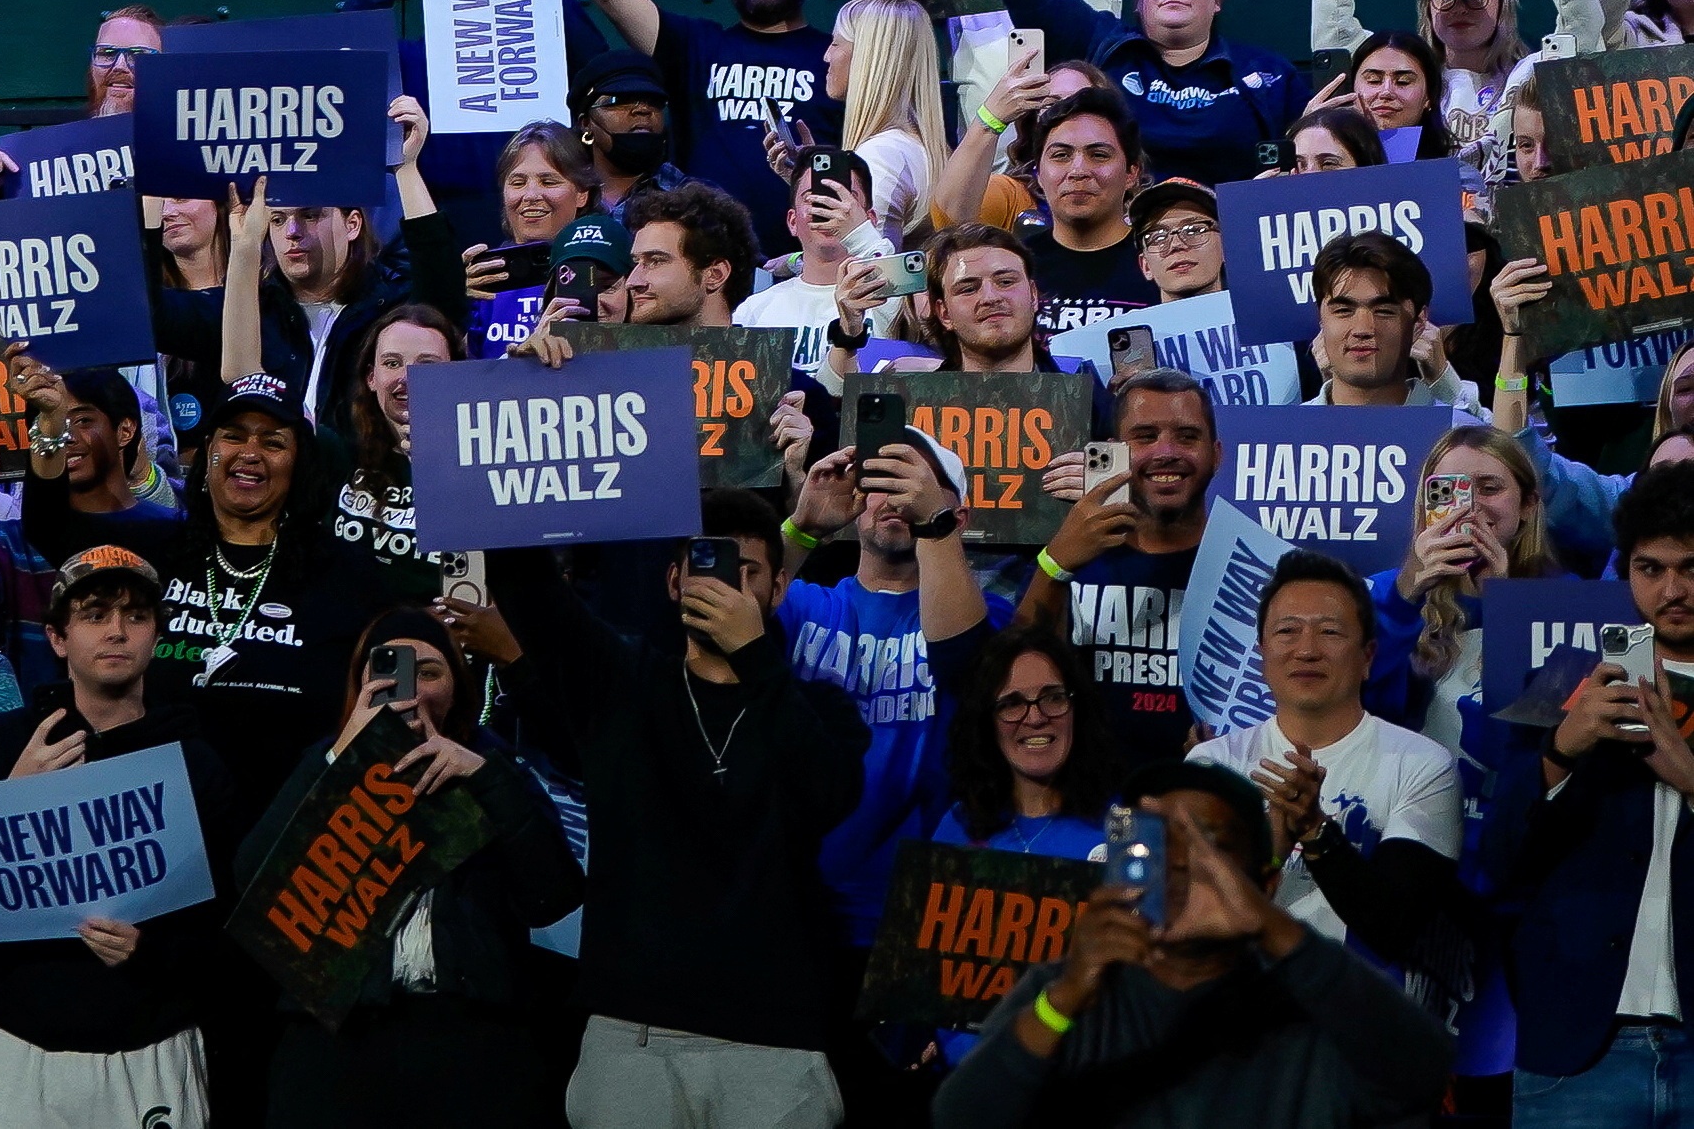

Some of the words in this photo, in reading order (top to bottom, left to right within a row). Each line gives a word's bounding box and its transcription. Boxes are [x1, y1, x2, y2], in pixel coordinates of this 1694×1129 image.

[455, 20, 495, 86] NEW
[459, 91, 497, 113] A
[707, 63, 816, 102] HARRIS
[176, 84, 345, 141] HARRIS
[717, 100, 794, 122] WAZ
[1574, 77, 1694, 144] HARR
[29, 146, 135, 198] HARRI
[201, 141, 319, 174] WALZ
[572, 228, 605, 241] APA
[1539, 179, 1694, 276] HARRI
[486, 323, 530, 343] OLD
[231, 373, 287, 391] HARRIS
[237, 383, 277, 395] WALZ
[692, 360, 757, 418] RIS
[458, 391, 648, 468] HARRIS
[912, 406, 1053, 471] ARRIS
[487, 460, 623, 507] WALZ
[1236, 443, 1407, 503] HARRIS
[335, 515, 364, 542] GO
[1260, 507, 1378, 541] WALZ
[169, 610, 303, 647] ducated.
[1071, 578, 1185, 652] HAR
[1189, 618, 1239, 720] NEW
[1219, 535, 1276, 634] WAY
[792, 621, 934, 694] HARRIS
[1094, 650, 1183, 687] PRESI
[1132, 692, 1177, 712] 2024
[80, 780, 168, 846] WAY
[267, 762, 418, 953] HARRIS
[323, 830, 426, 950] WALZ
[918, 881, 1086, 963] HARR
[940, 959, 1016, 1001] WA
